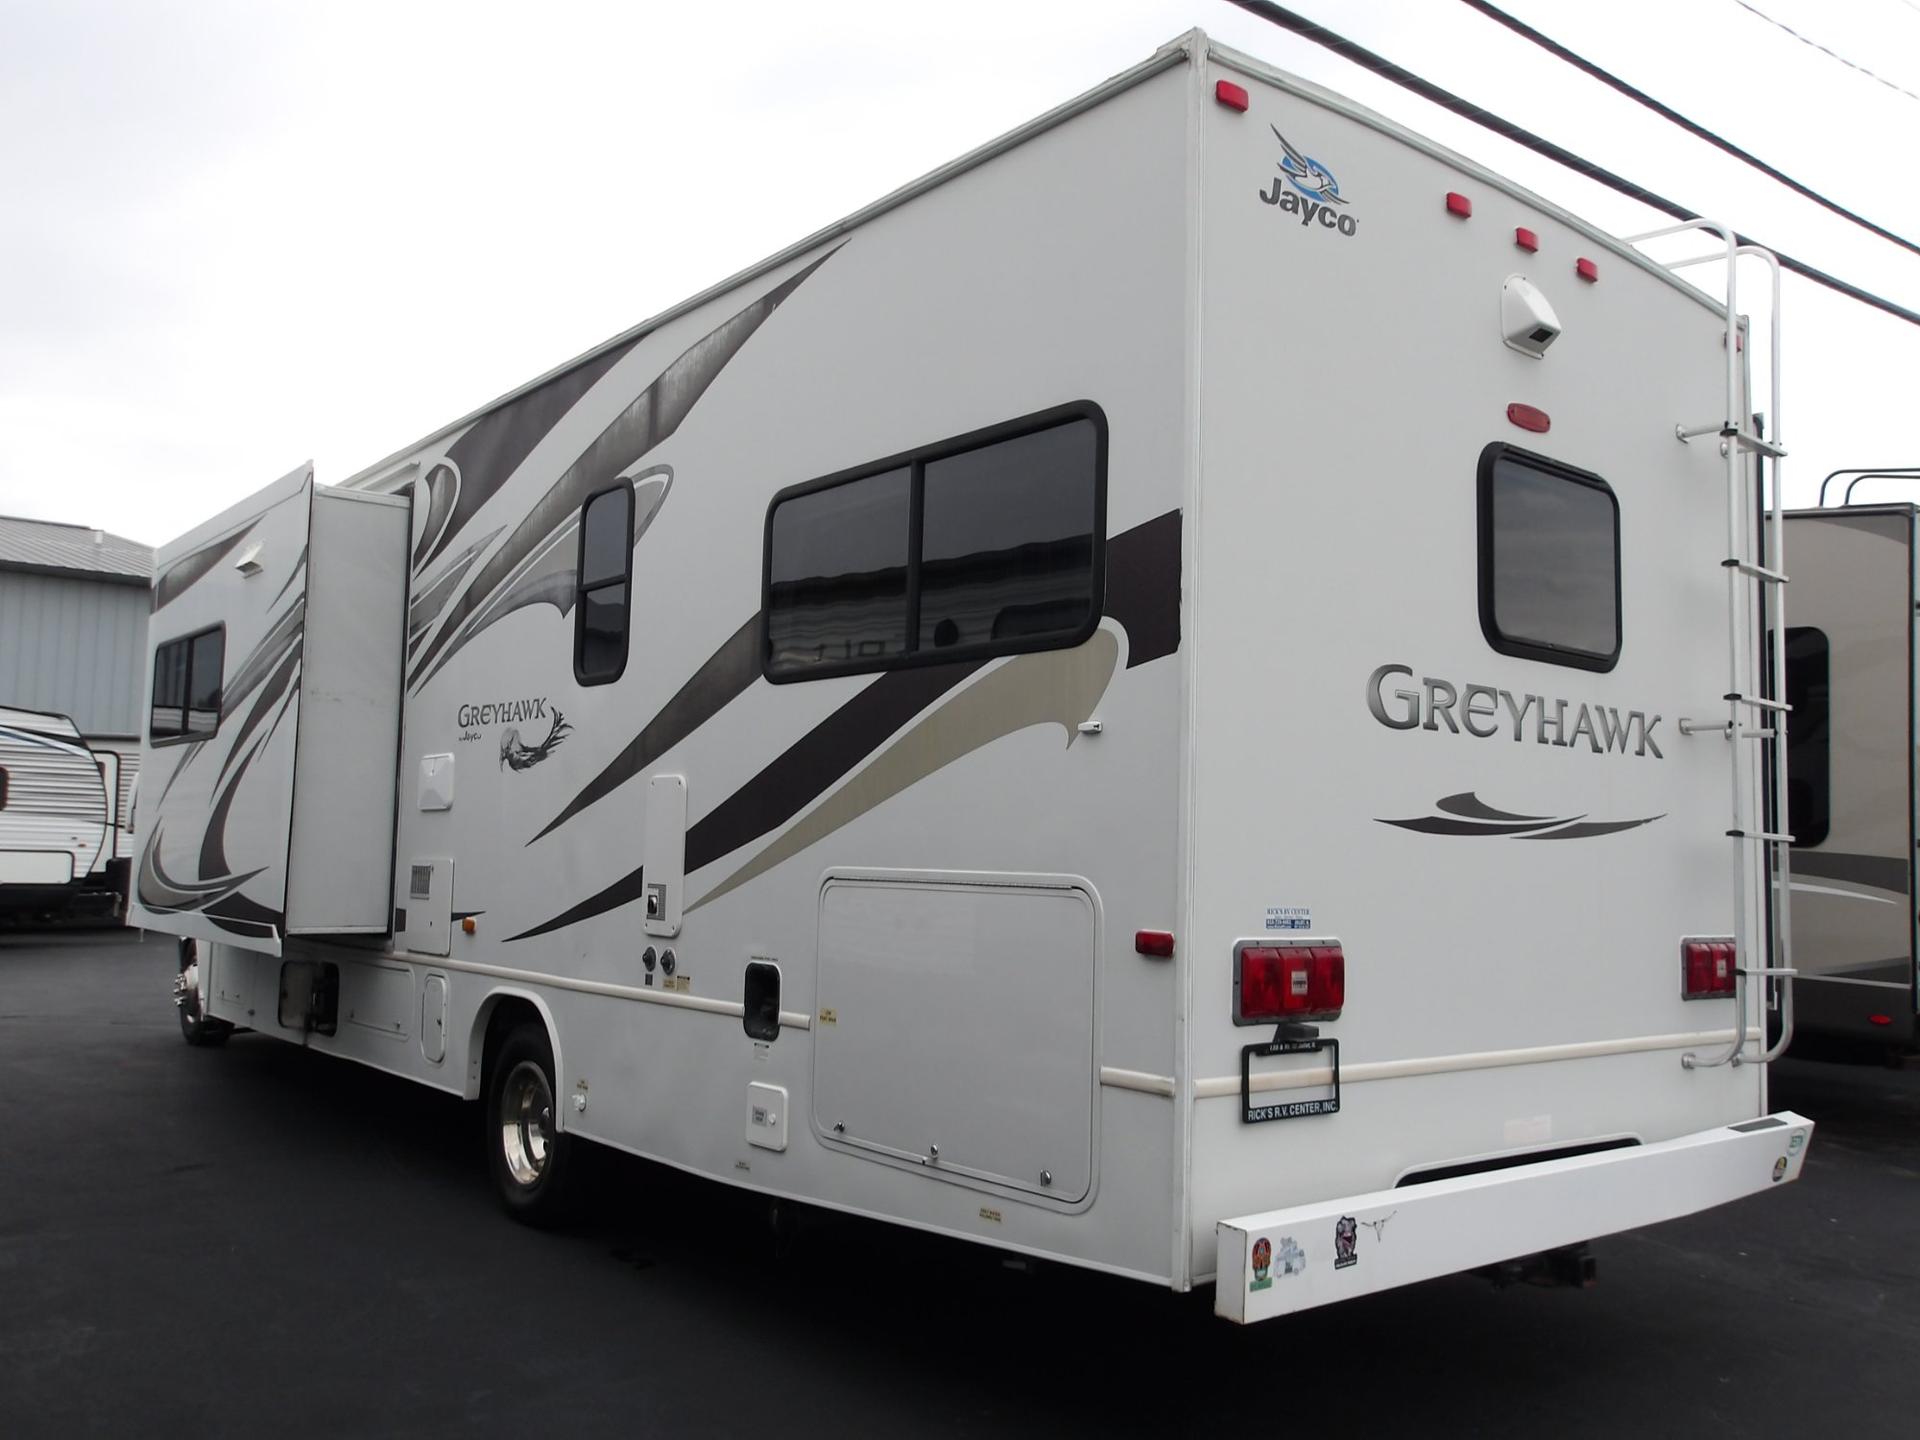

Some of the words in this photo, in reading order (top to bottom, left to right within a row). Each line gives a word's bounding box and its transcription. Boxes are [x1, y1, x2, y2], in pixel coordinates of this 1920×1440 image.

[1259, 176, 1357, 237] Jayco
[458, 697, 547, 728] GREYHAWK
[1366, 663, 1665, 760] GREYHAWK
[1247, 1106, 1274, 1121] RICK'S
[1274, 1104, 1288, 1118] R.V.
[1323, 1100, 1338, 1112] INC.
